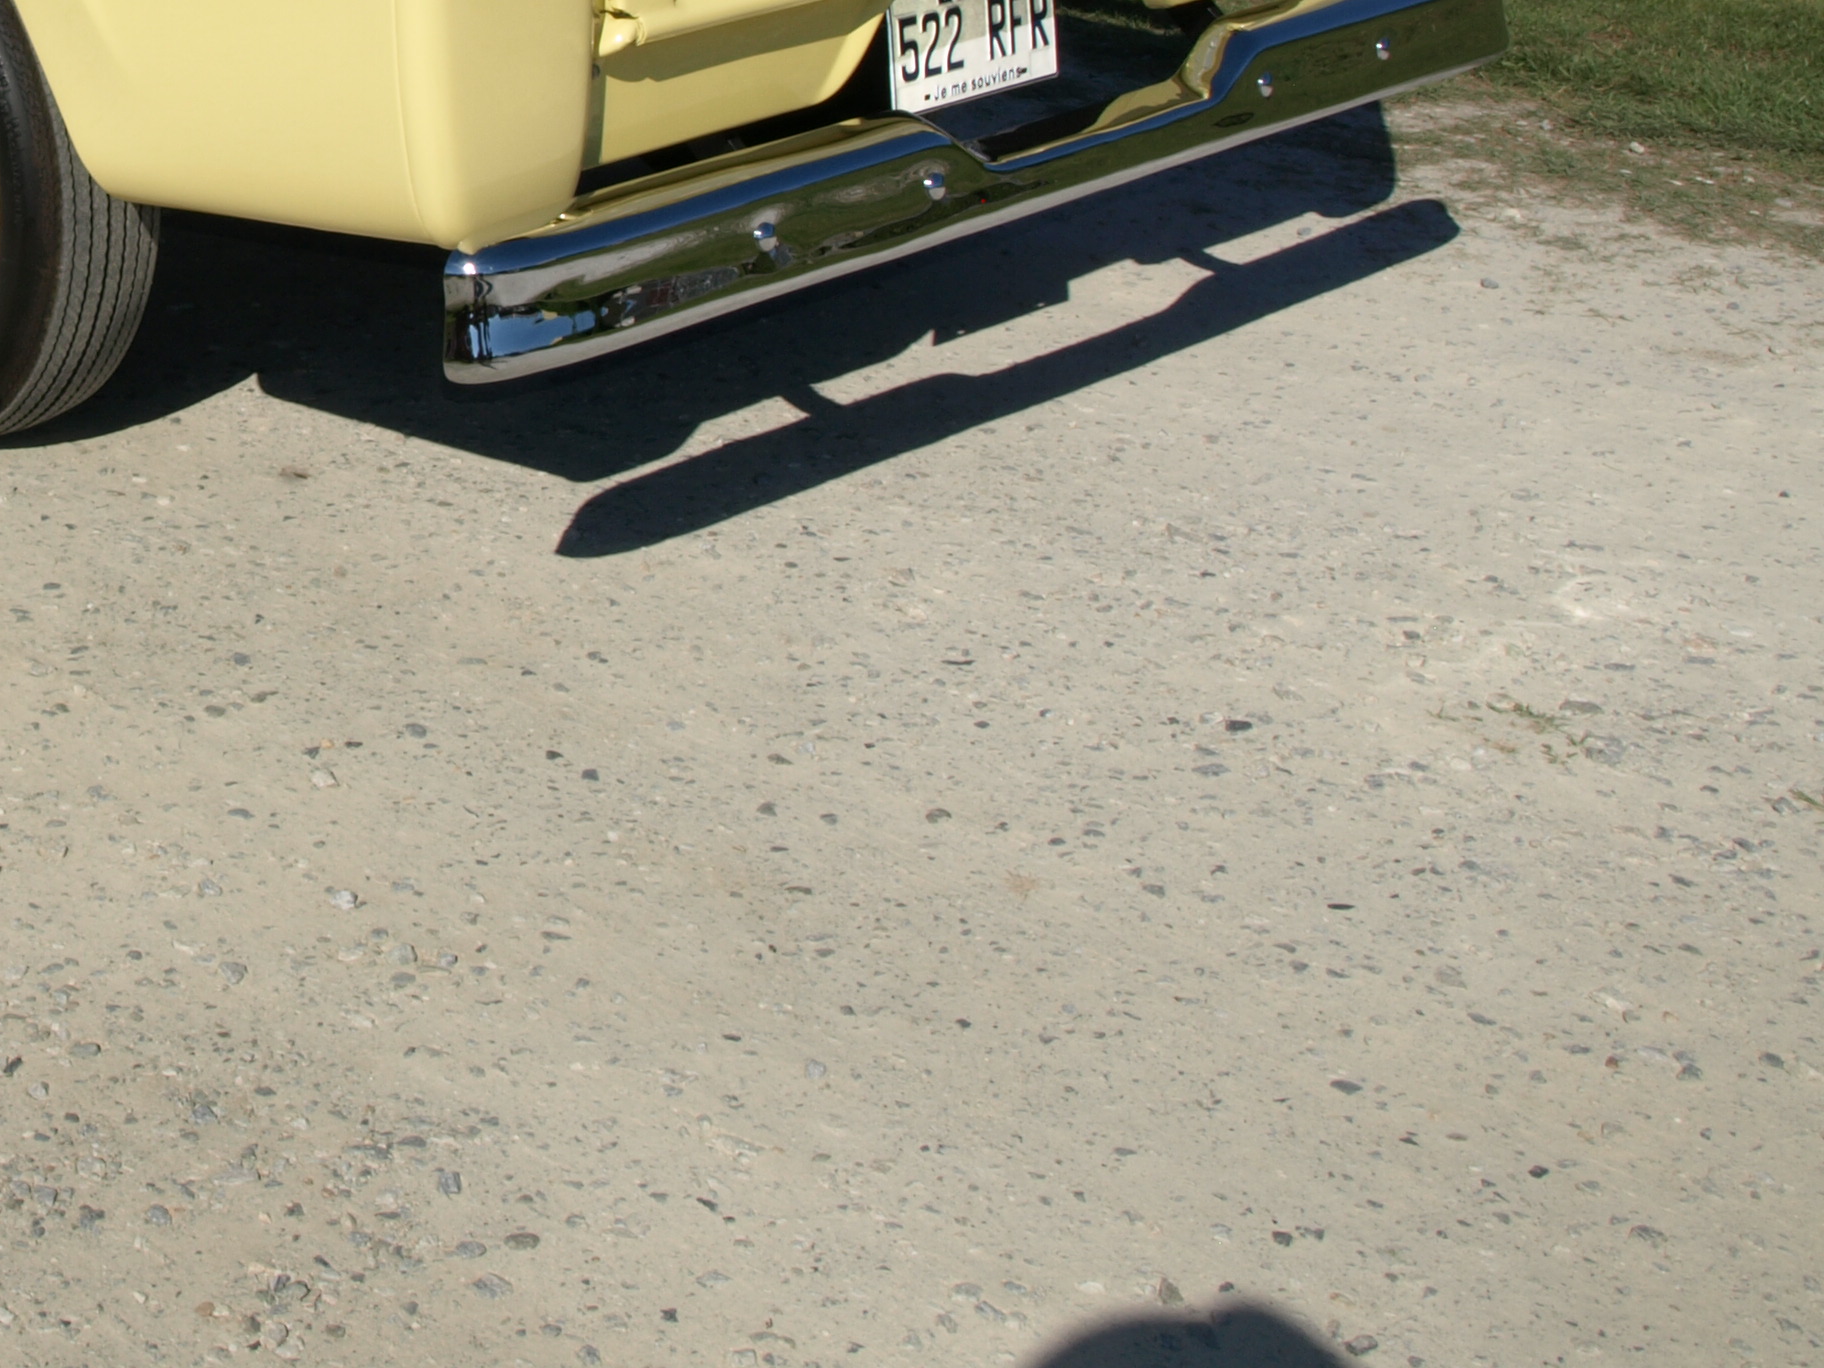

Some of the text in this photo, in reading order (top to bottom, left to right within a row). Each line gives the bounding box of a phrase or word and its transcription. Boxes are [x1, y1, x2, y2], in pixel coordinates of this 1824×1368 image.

[897, 6, 965, 82] 522
[934, 66, 1021, 101] Je me souviens
